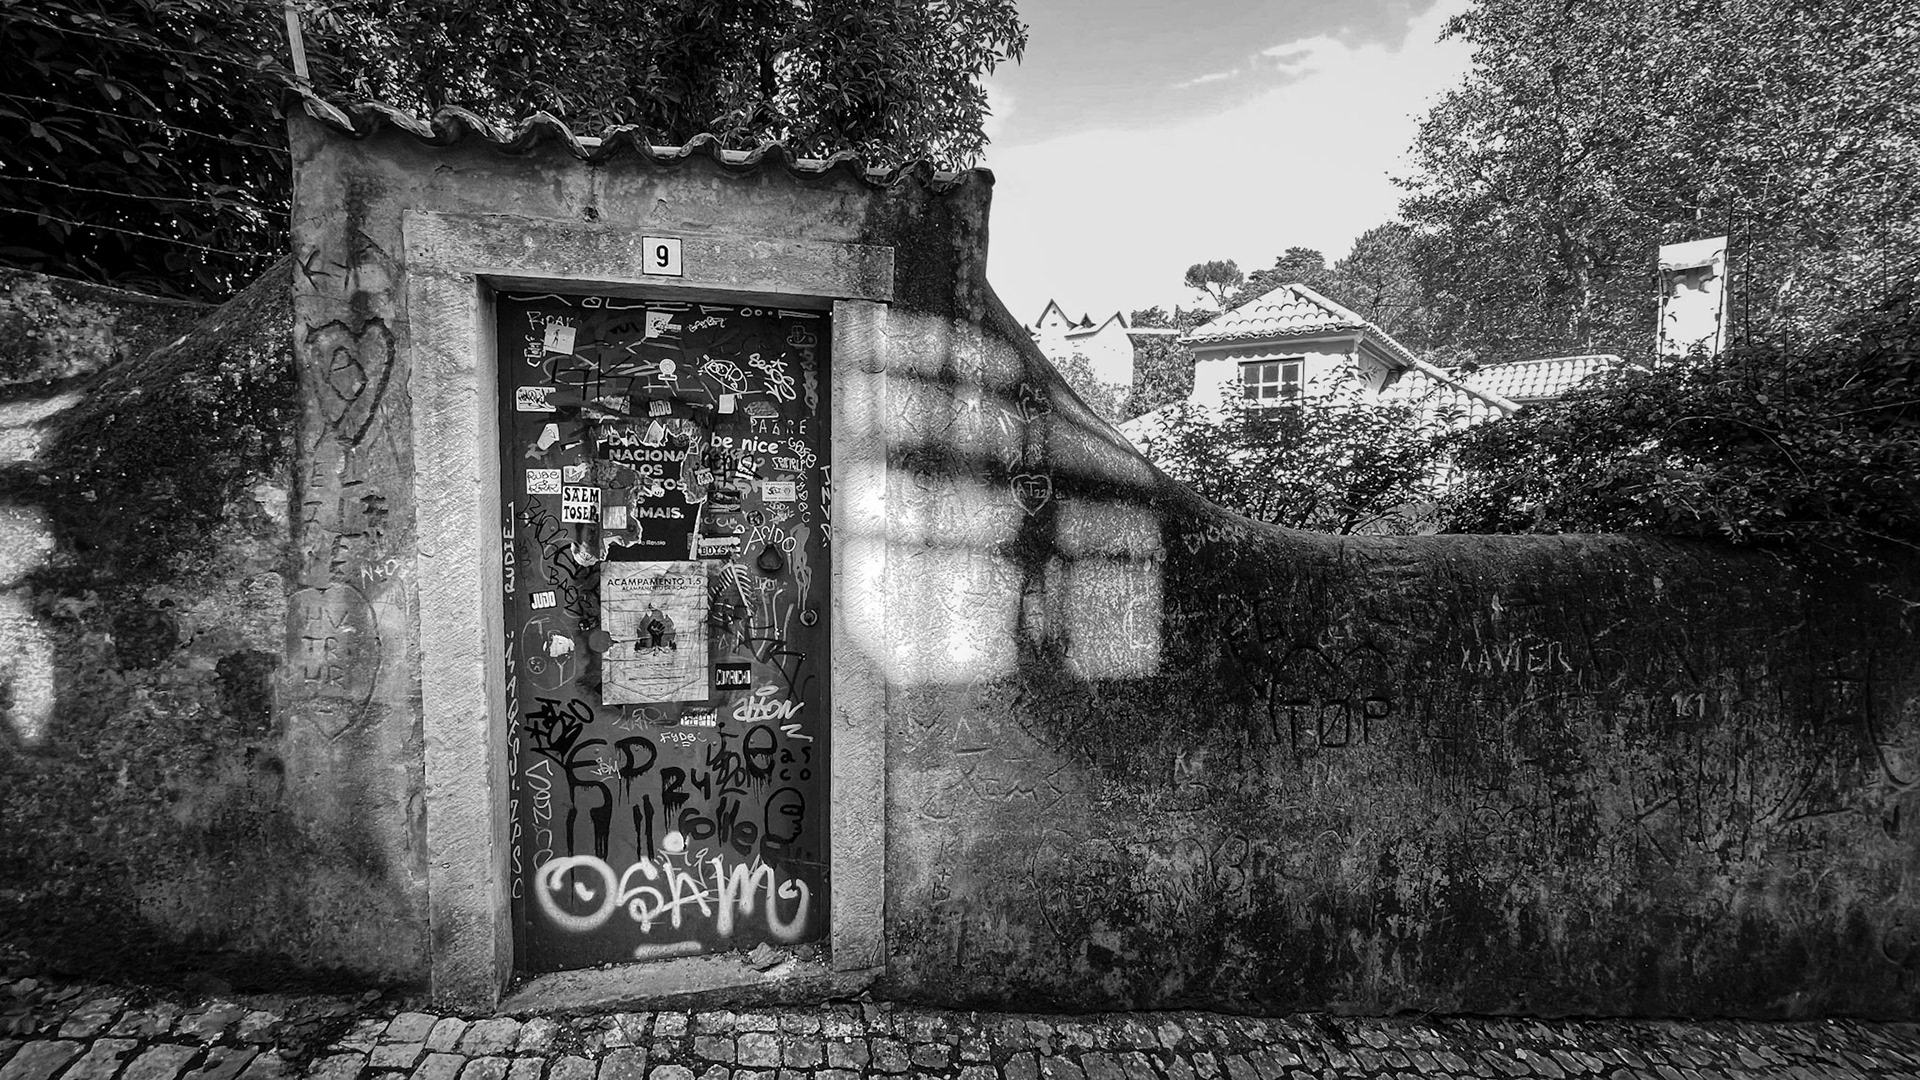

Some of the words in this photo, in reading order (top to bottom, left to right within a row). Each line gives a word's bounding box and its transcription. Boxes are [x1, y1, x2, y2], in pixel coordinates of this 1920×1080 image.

[656, 244, 669, 268] 9
[711, 432, 733, 448] be
[741, 436, 779, 454] nice
[564, 487, 600, 503] SAEM
[701, 545, 726, 555] BOYS
[607, 577, 684, 586] ACAMPAMENTO
